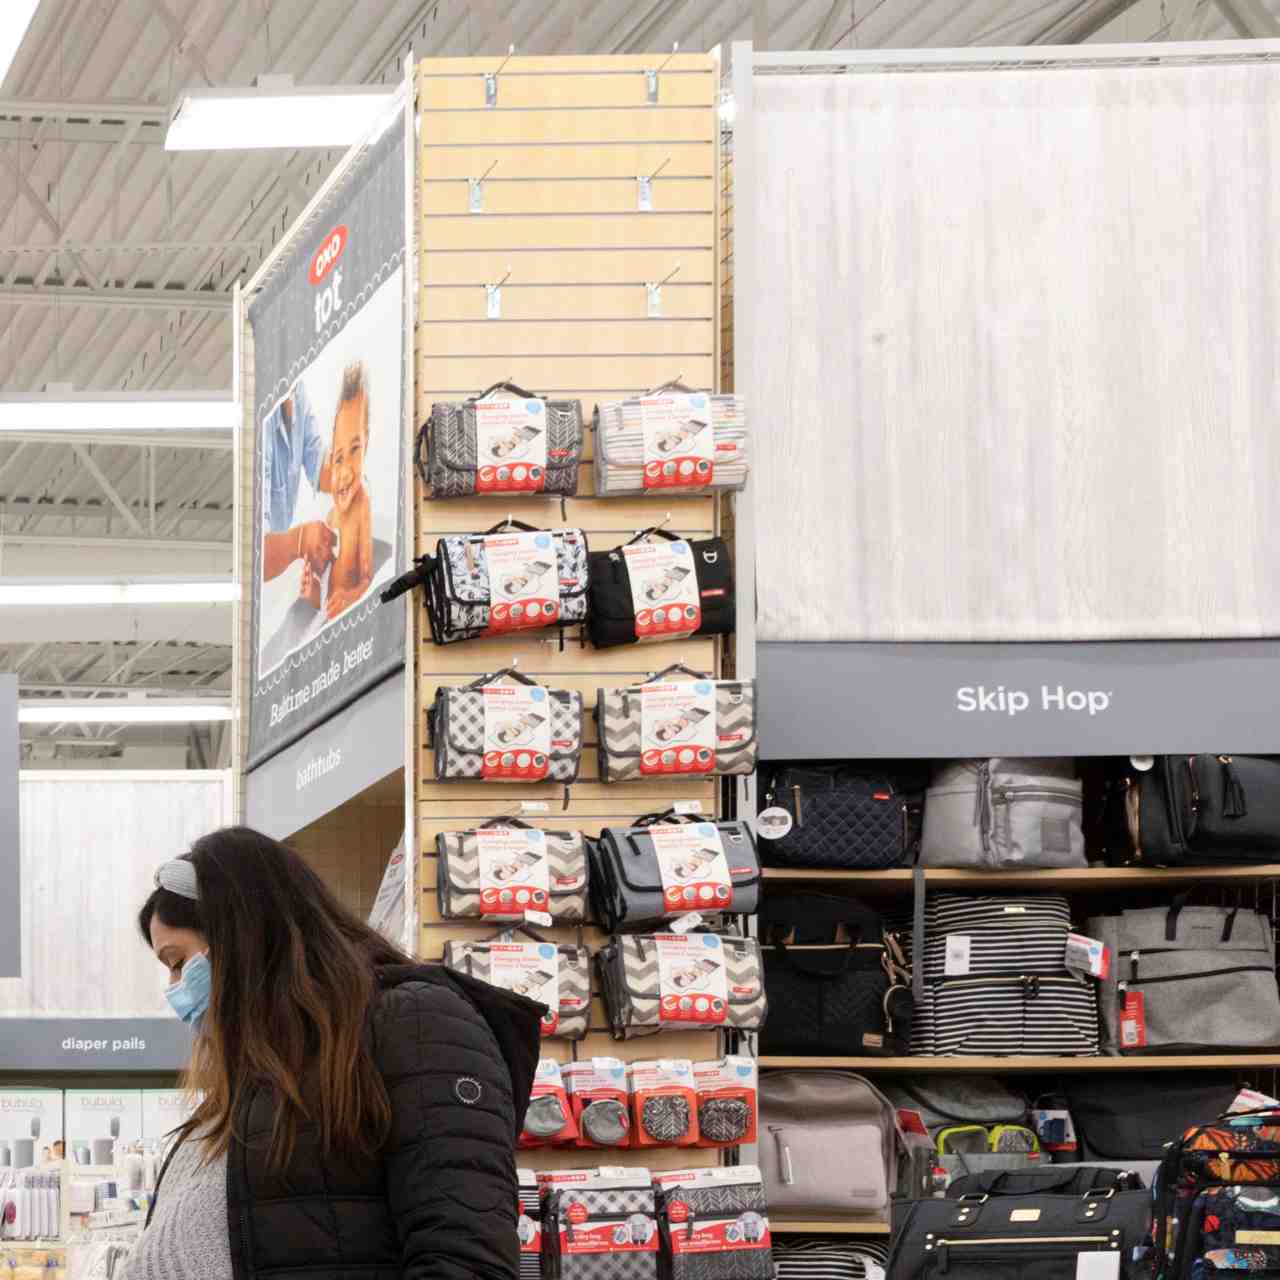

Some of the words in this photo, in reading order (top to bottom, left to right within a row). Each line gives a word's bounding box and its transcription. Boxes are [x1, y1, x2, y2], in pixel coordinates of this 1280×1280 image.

[311, 659, 341, 699] made
[956, 685, 1030, 716] Skip
[1041, 684, 1110, 716] Hop
[296, 748, 341, 791] bathtubs
[61, 1036, 108, 1052] diaper
[112, 1036, 146, 1052] pails
